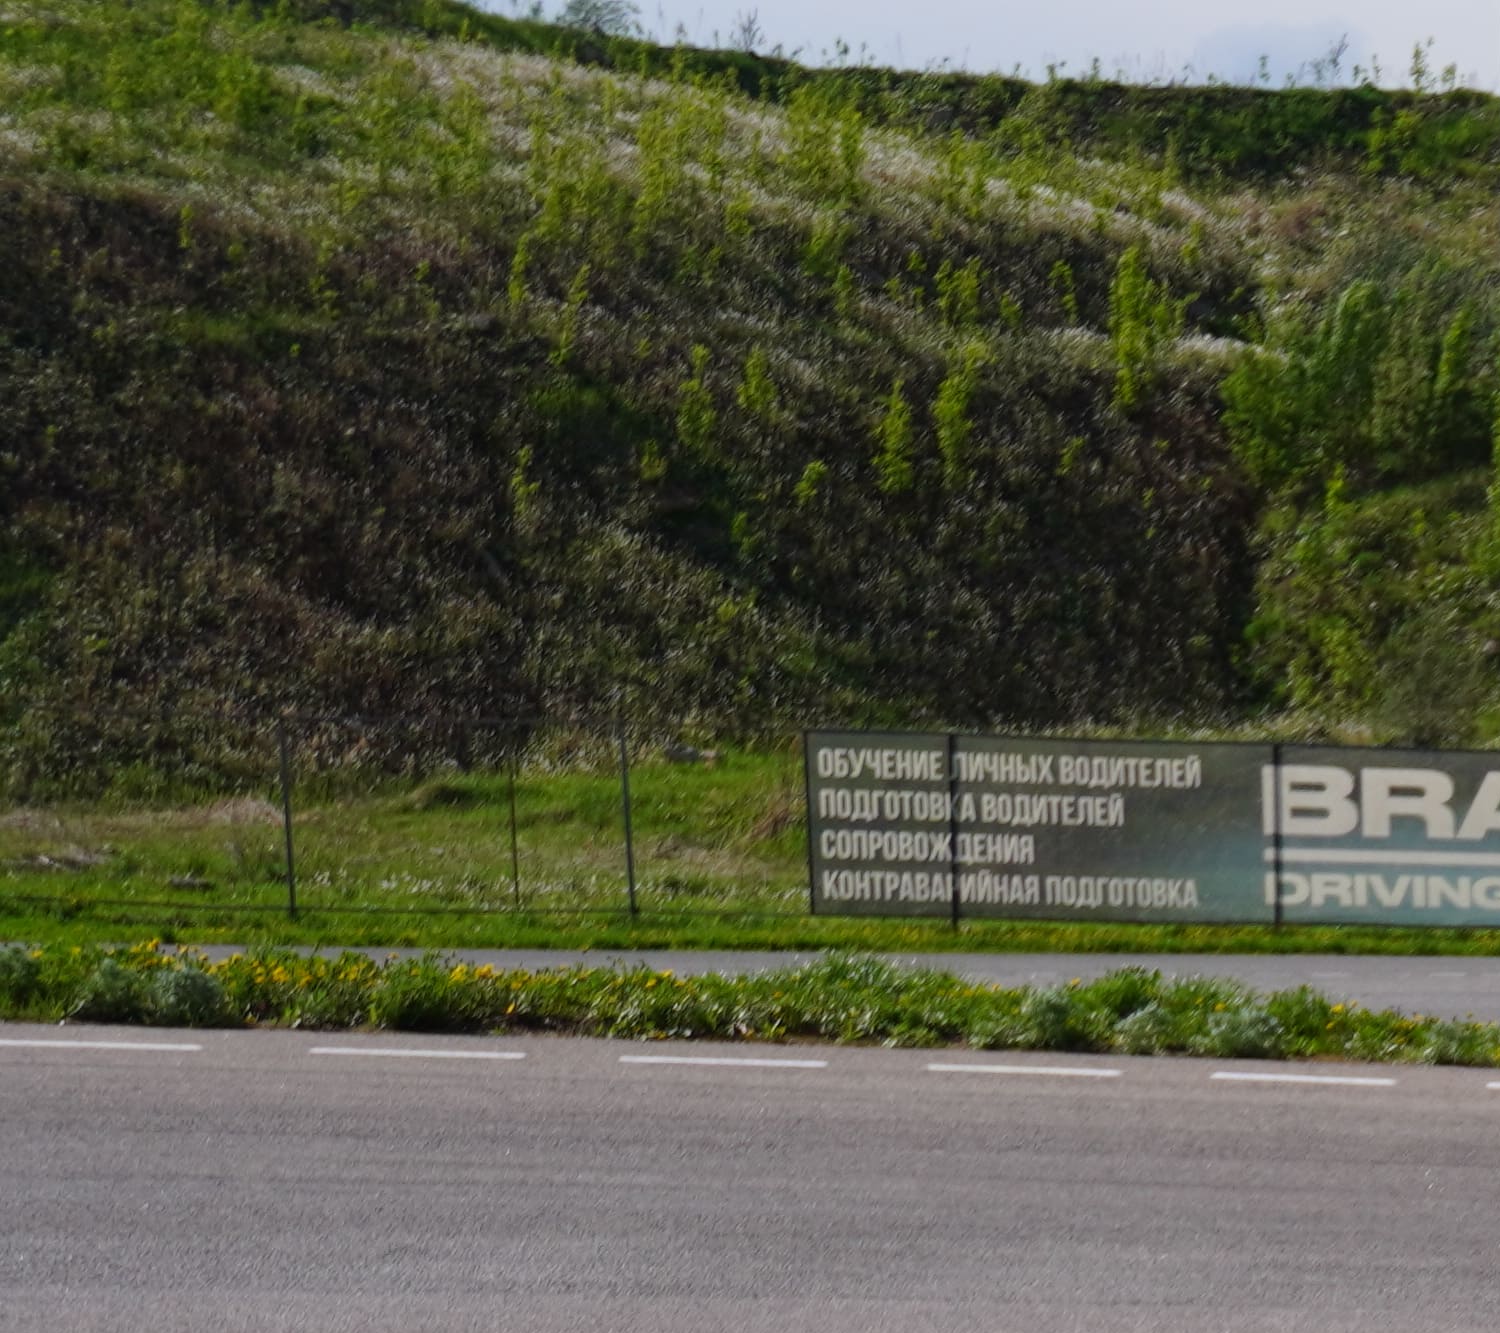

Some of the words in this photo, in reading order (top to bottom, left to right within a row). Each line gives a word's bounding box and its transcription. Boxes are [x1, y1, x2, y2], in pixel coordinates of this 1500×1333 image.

[816, 747, 945, 781] ОБУЧЕНИЕ
[951, 750, 1054, 786] ЛИЧНЫХ
[1058, 754, 1202, 789] ВОДИТЕЛЕЙ
[818, 787, 977, 823] ПОДГОТОВКА
[981, 792, 1125, 828] ВОДИТЕЛЕЙ
[820, 828, 1035, 865] СОПРОВОЖДЕНИЯ
[1045, 874, 1199, 909] ПОДГОТОВКА
